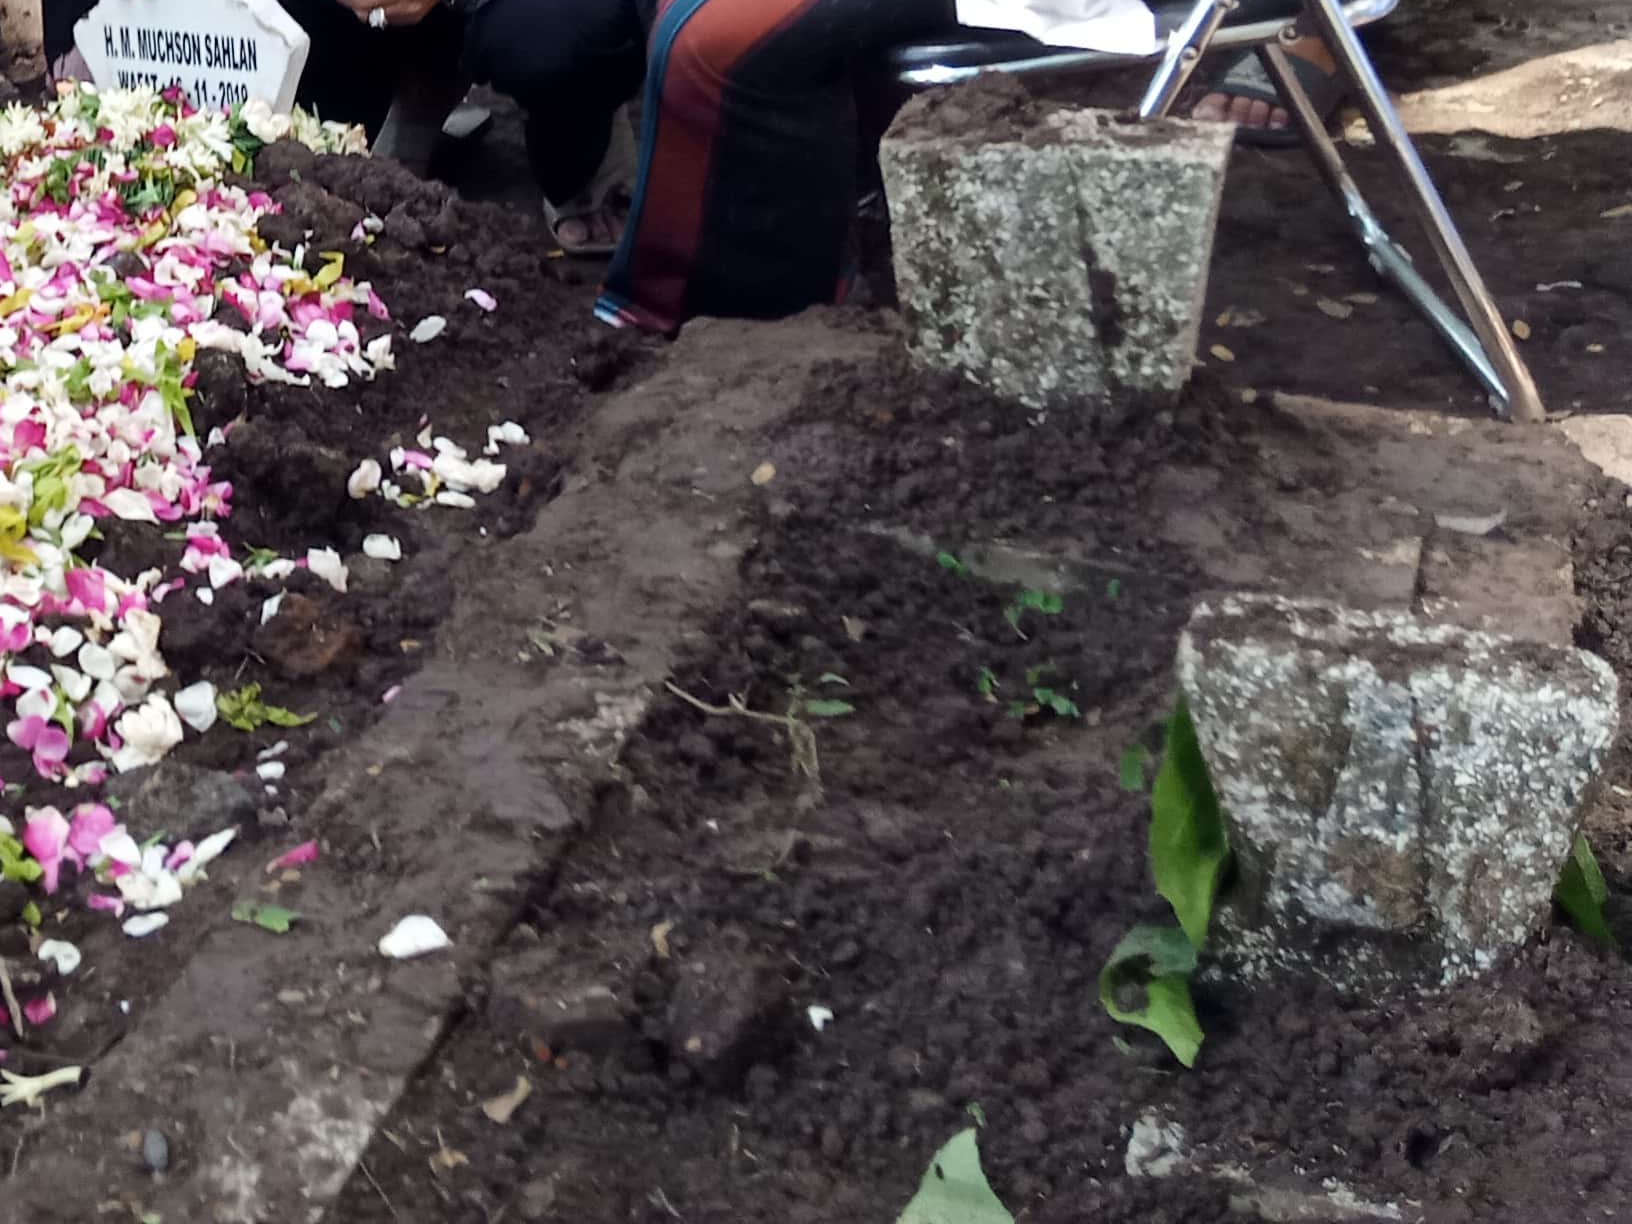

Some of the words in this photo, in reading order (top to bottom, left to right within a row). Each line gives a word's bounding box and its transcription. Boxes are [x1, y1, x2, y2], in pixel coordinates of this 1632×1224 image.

[104, 24, 118, 57] H.
[119, 26, 136, 59] M.
[136, 28, 202, 66] MUCHSON
[204, 33, 258, 72] SAHLAN
